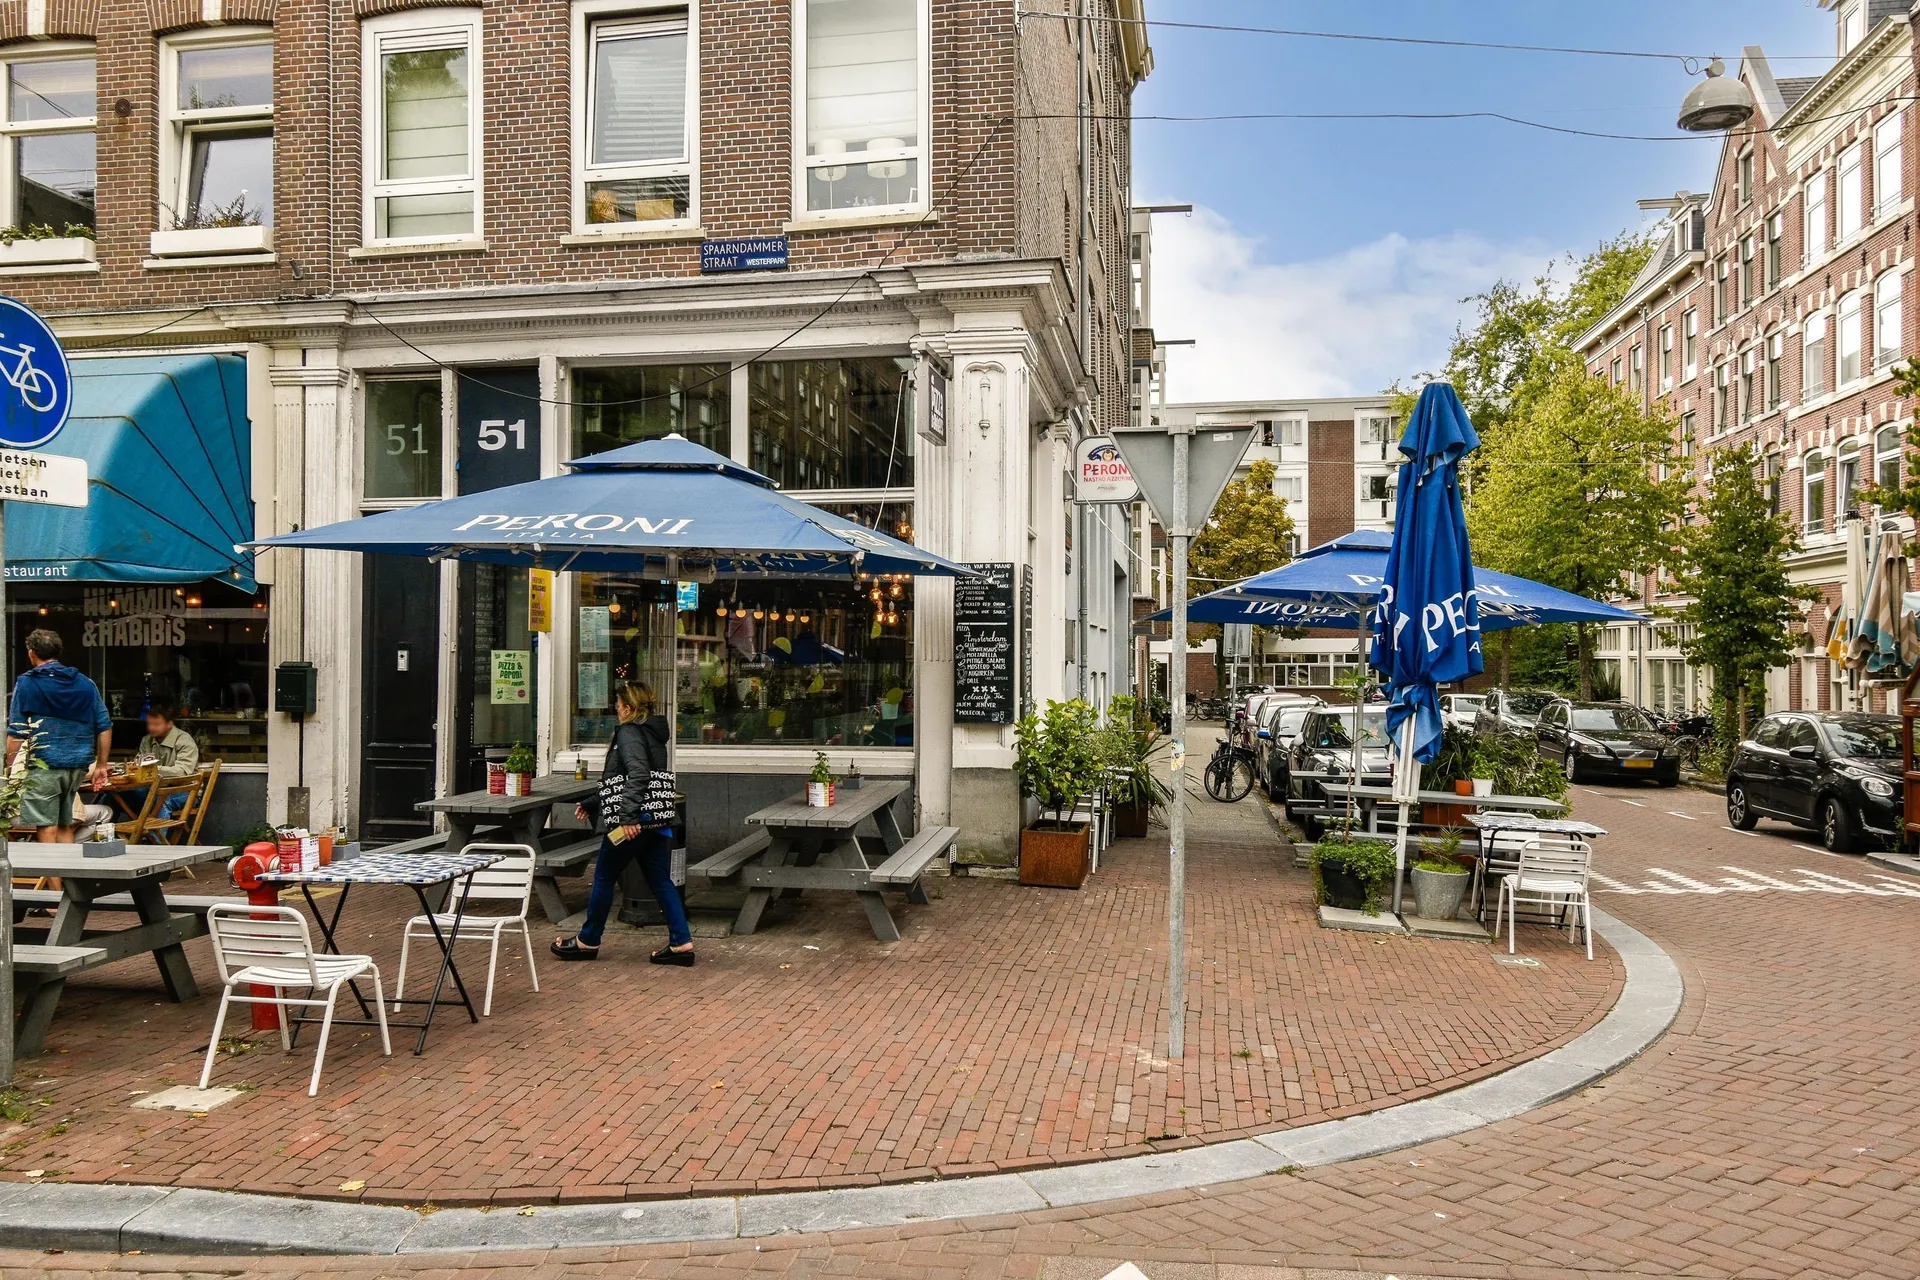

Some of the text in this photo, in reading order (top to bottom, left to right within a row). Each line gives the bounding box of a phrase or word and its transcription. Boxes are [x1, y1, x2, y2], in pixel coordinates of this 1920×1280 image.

[703, 241, 784, 256] SPAARNDAMMER
[703, 256, 786, 269] STRAAT WESTERPARK
[386, 423, 429, 456] 51
[477, 419, 526, 451] 51
[0, 452, 47, 468] ietsen
[0, 467, 21, 480] iet
[1083, 463, 1128, 476] PERON
[452, 513, 694, 535] PERONI
[504, 531, 595, 540] ITALIA
[4, 564, 68, 577] staurant
[83, 587, 186, 617] HUMMUS
[963, 630, 1008, 643] Amsterdam
